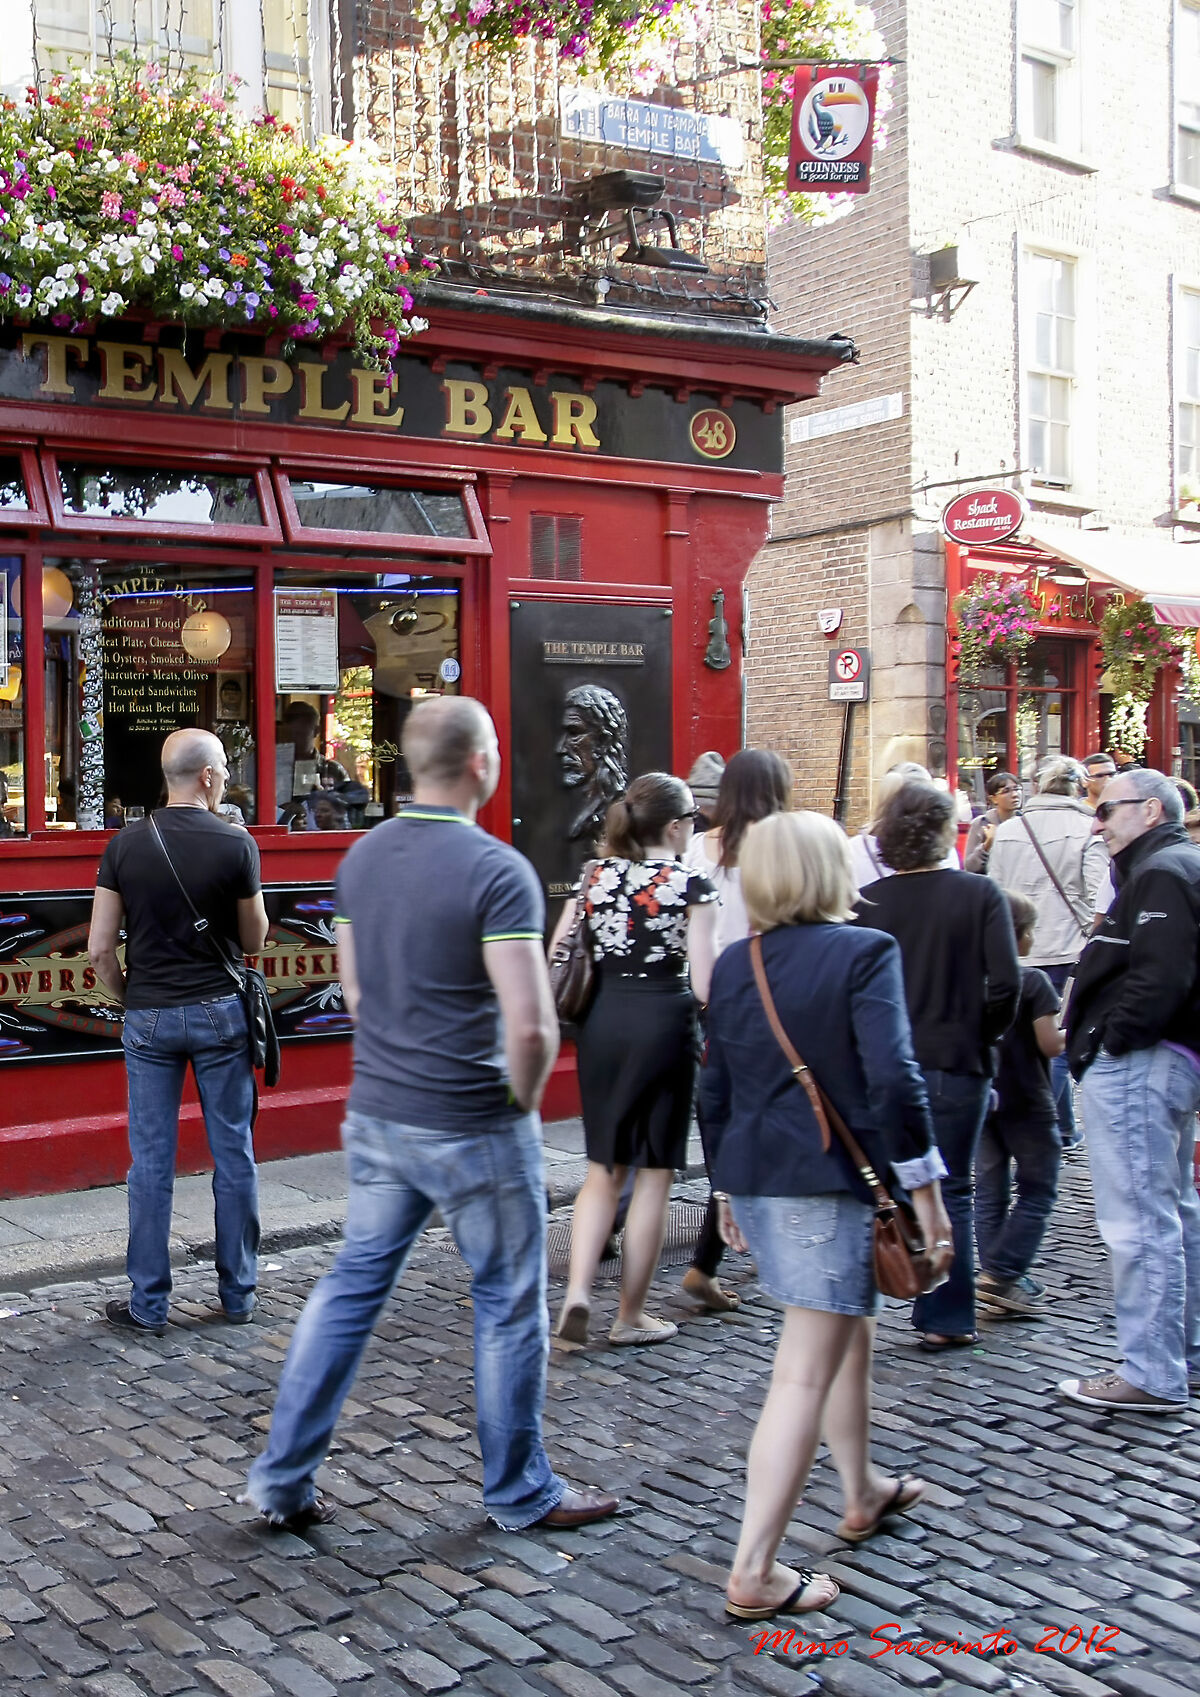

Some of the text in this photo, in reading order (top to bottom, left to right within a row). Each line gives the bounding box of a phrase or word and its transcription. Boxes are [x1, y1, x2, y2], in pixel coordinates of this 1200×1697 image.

[607, 105, 640, 125] BARRA
[644, 111, 659, 127] AN
[618, 125, 700, 157] TEMPLE BAR
[800, 161, 860, 174] GUINNESS
[800, 171, 859, 183] is good for you
[19, 332, 405, 427] TEMPLE
[443, 379, 601, 447] BAR
[696, 416, 728, 450] 48
[968, 497, 998, 516] Shack
[953, 514, 1012, 531] Restaurant
[92, 577, 166, 611] TEMPLE
[122, 636, 147, 649] Plate,
[544, 642, 645, 657] THE TEMPLE BAR
[112, 652, 148, 667] Oysters,
[150, 653, 185, 665] Smoked
[153, 670, 181, 682] Meats,
[183, 669, 209, 680] Olives
[111, 685, 197, 697] Toasted Sandwiches
[108, 701, 200, 713] Hot Roast Beef Rolls
